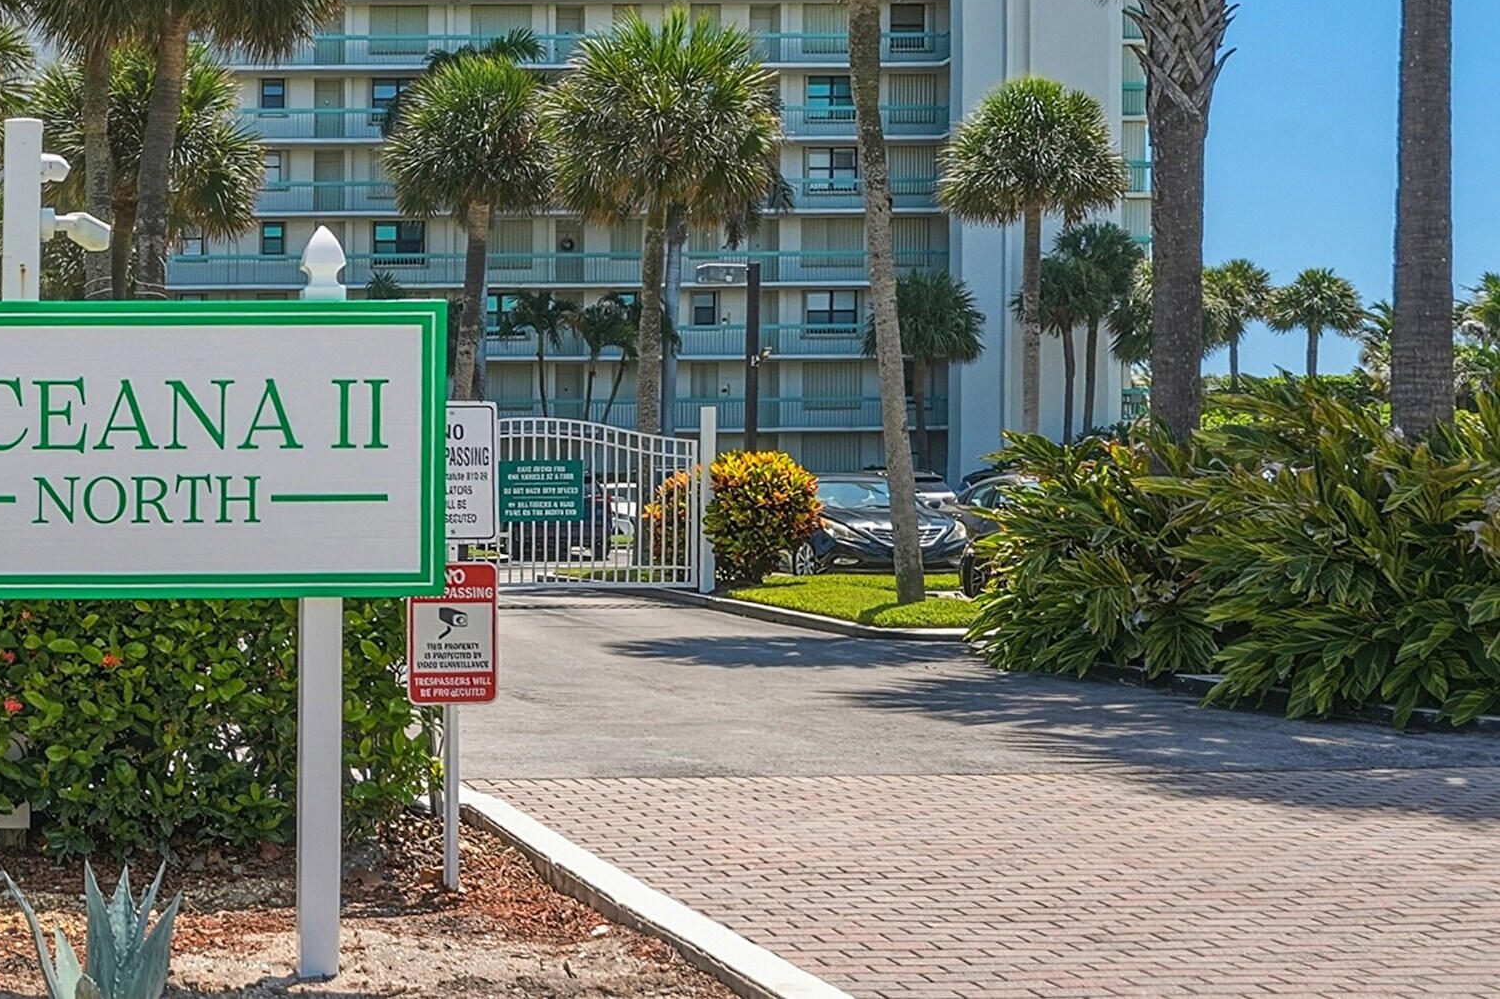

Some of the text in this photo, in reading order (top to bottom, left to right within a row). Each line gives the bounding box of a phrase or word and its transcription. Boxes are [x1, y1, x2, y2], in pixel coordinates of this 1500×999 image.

[331, 379, 390, 448] II
[445, 447, 489, 466] PASSING
[32, 474, 261, 524] NORTH
[444, 642, 479, 650] PROPERTY
[415, 676, 492, 687] TRESPASSERS WILL
[420, 687, 486, 698] BE PROSECUTED
